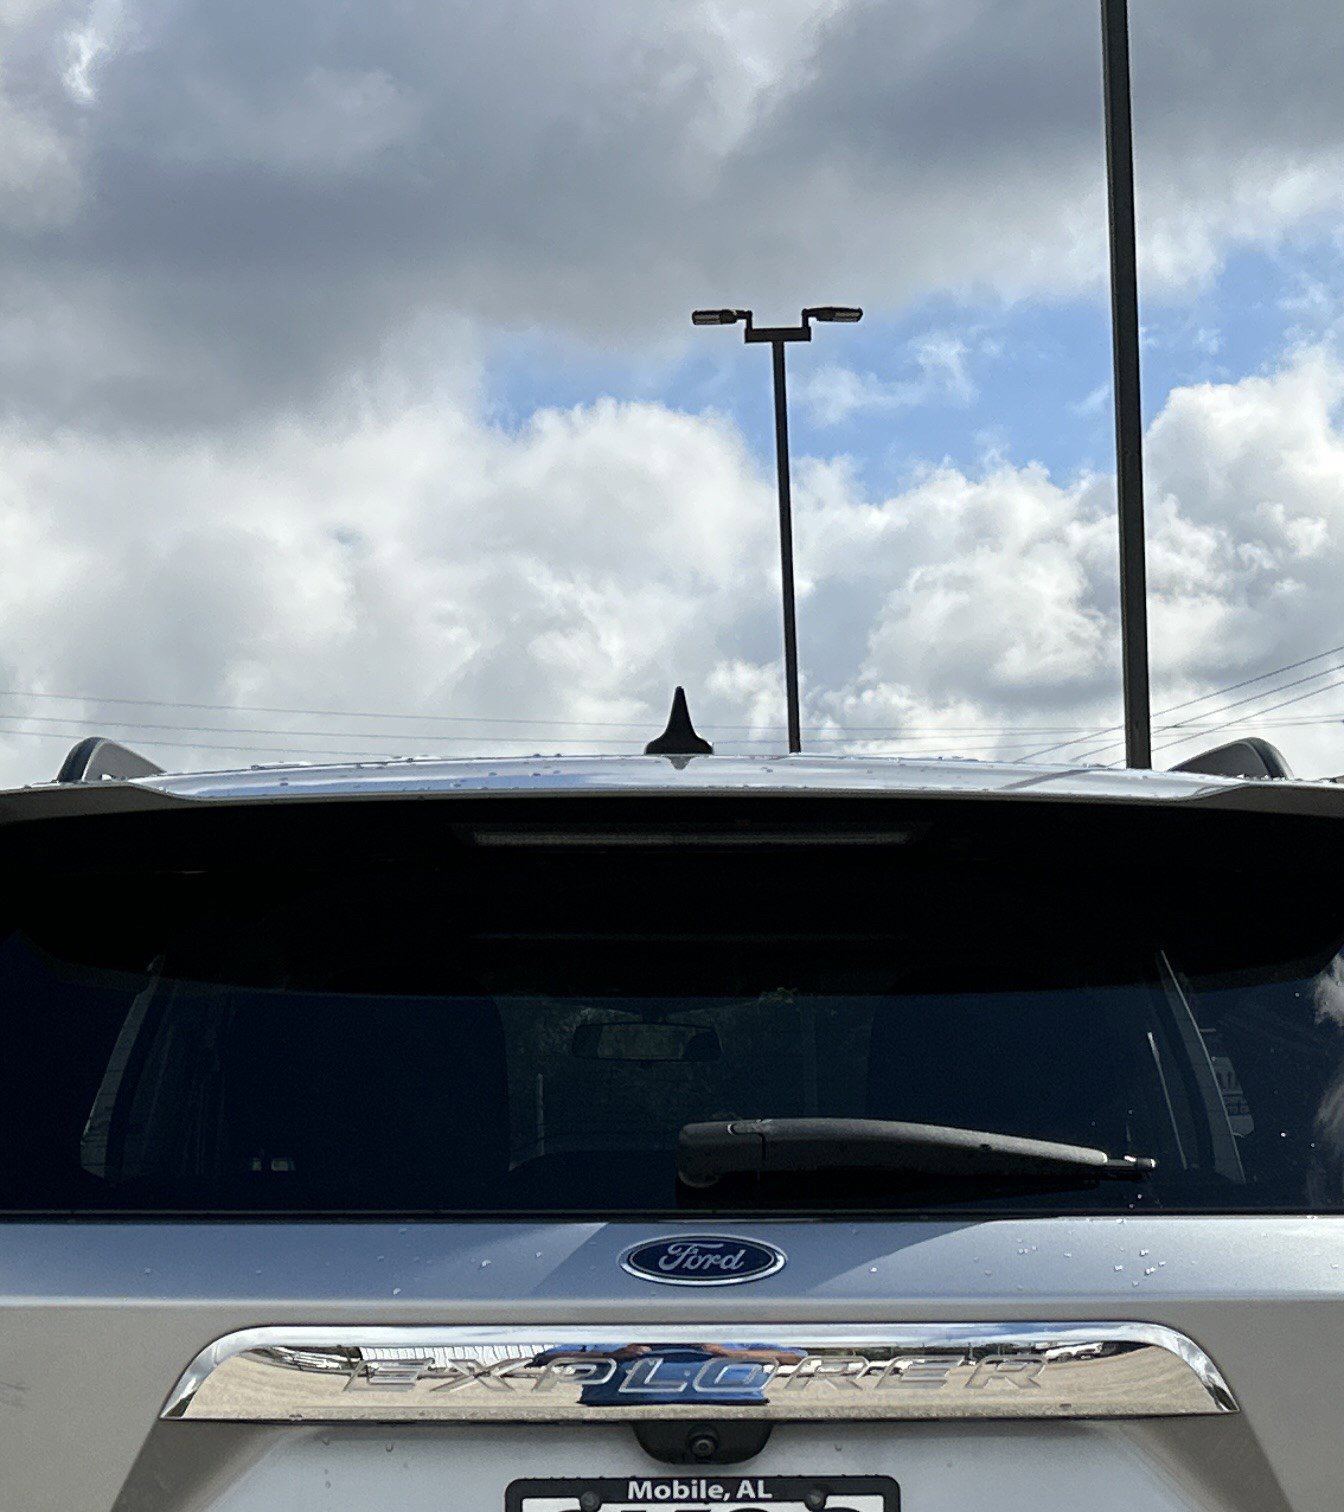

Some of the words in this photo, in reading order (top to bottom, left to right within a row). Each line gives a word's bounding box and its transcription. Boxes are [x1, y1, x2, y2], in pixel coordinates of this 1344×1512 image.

[658, 1242, 746, 1271] Ford
[342, 1353, 1049, 1395] EXPLORER
[627, 1480, 732, 1503] Mobile,
[736, 1480, 773, 1499] AL
